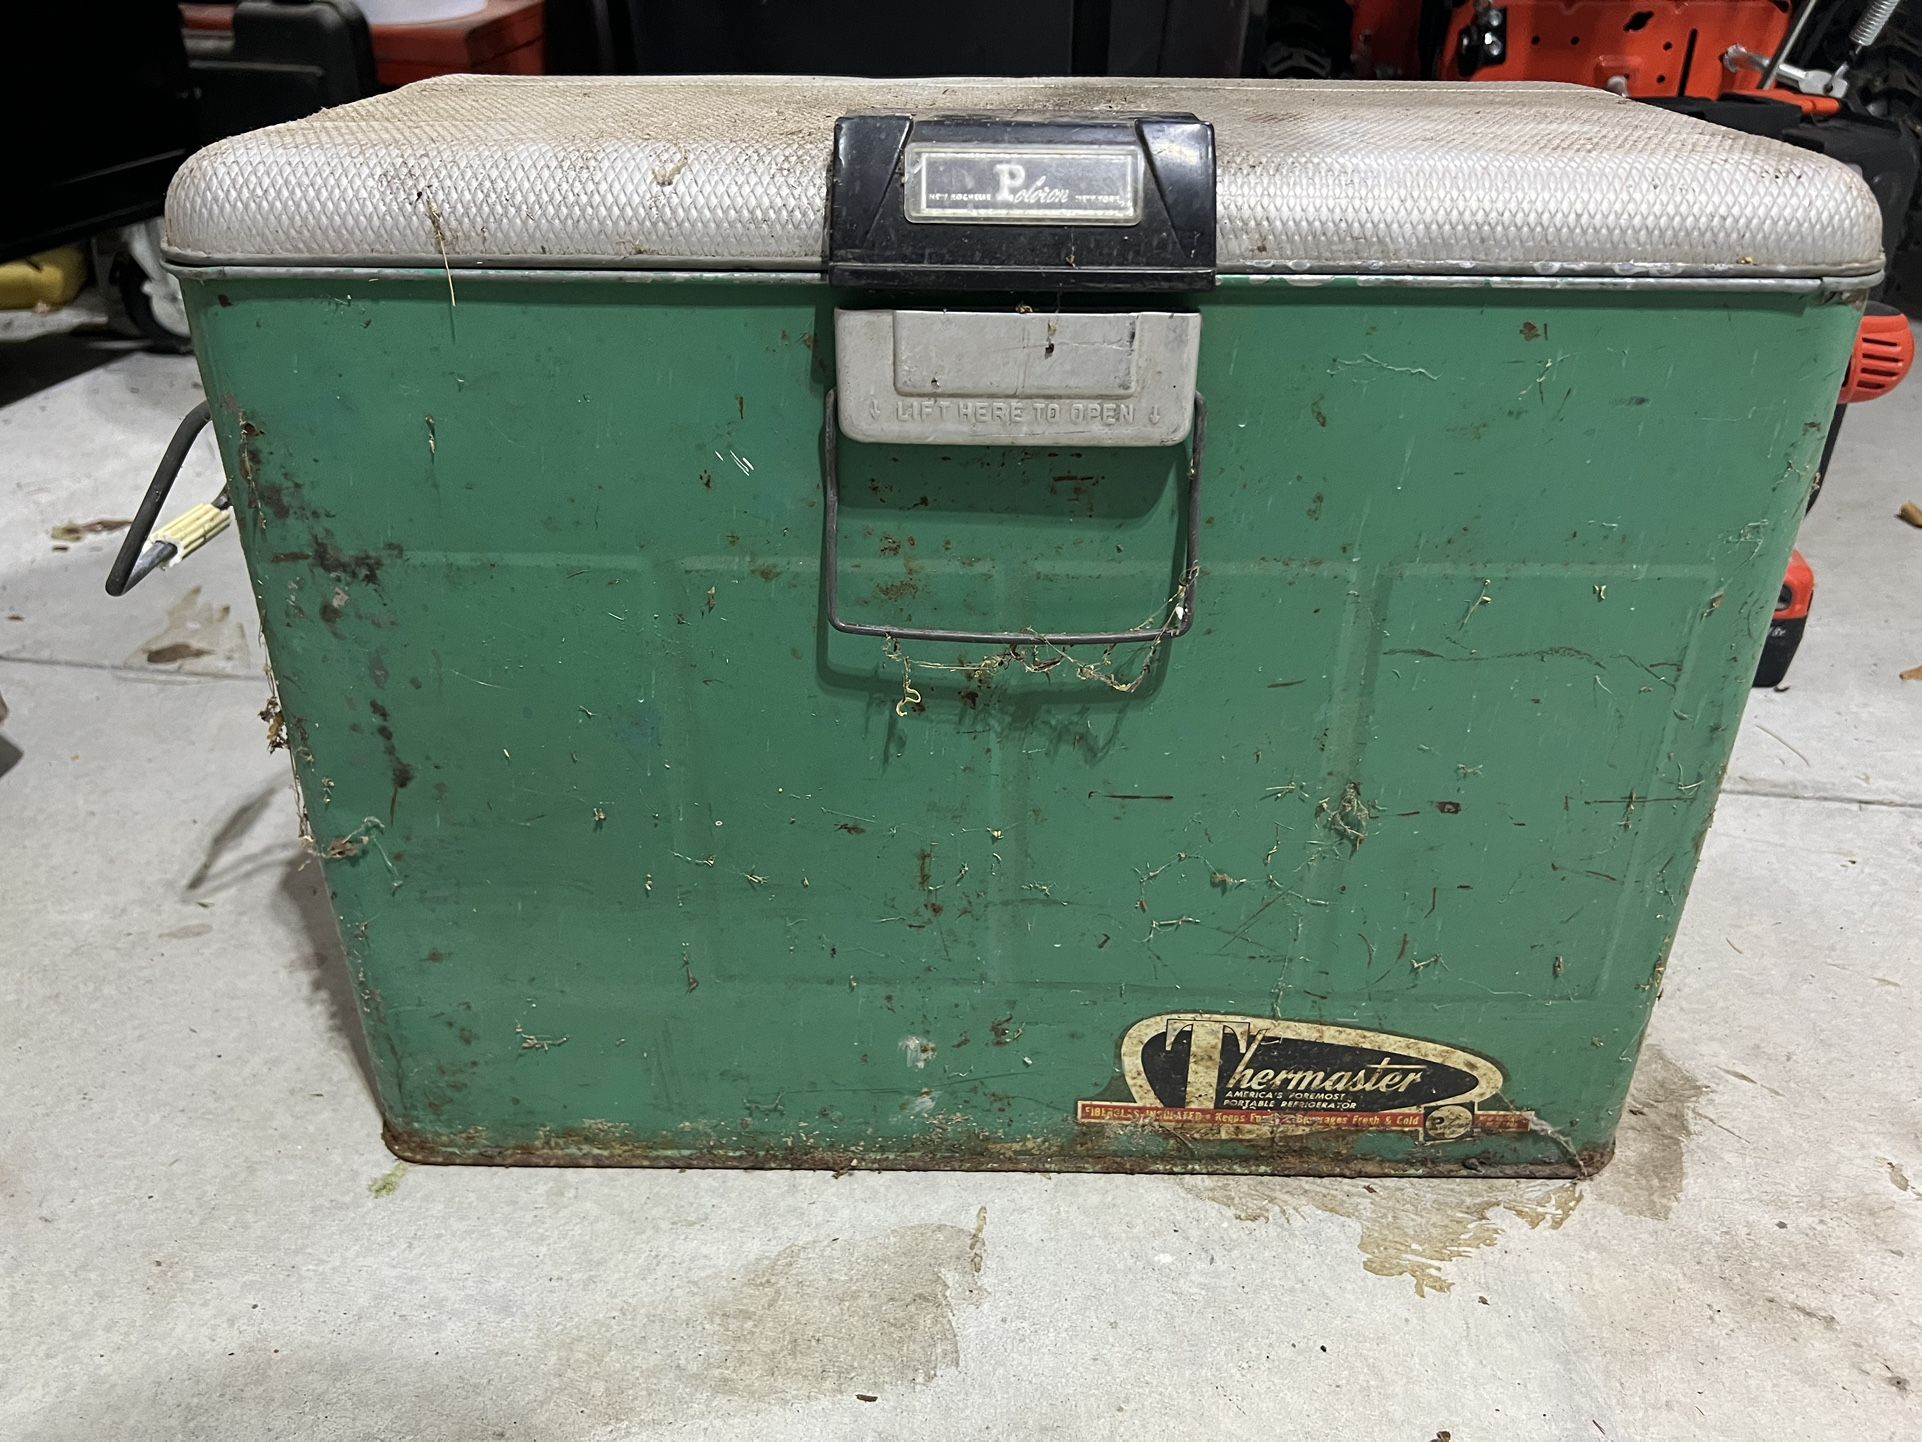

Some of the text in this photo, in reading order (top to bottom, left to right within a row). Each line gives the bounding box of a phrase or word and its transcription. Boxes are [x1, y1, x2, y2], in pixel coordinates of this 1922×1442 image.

[993, 163, 1070, 204] Poloron
[897, 401, 1135, 425] LIFT HERE TO OPEN
[1165, 1018, 1427, 1109] Thermaster
[1223, 1099, 1357, 1110] PORTABLE REFRIGERATOR
[1225, 1090, 1345, 1101] AMERICA'S FOREMOST
[1215, 1112, 1246, 1123] Keeps
[1353, 1115, 1380, 1126] Fresh
[1396, 1115, 1419, 1126] Cold
